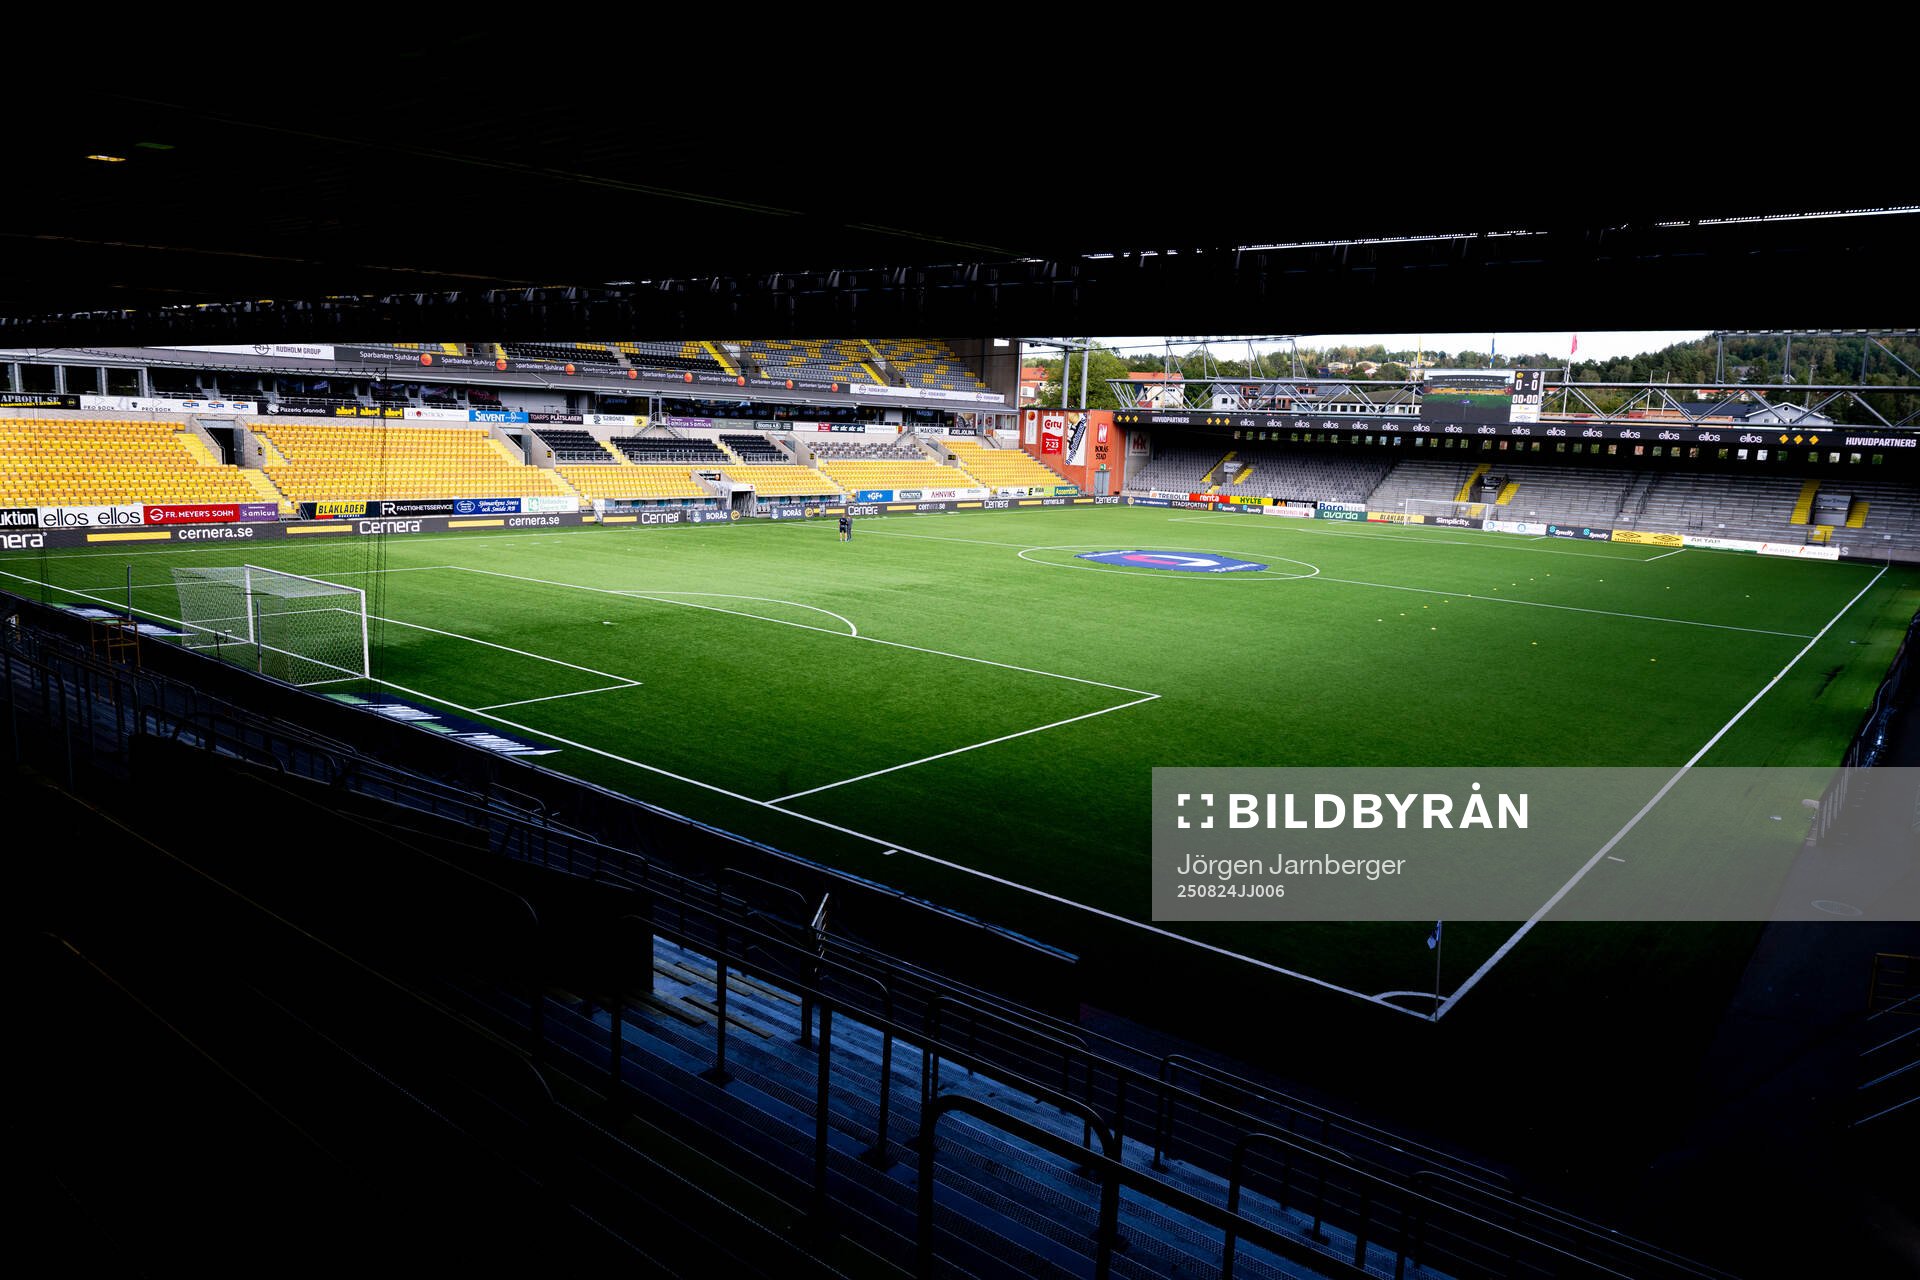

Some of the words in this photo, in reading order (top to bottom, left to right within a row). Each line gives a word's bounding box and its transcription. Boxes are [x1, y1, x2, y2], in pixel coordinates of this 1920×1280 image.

[303, 347, 321, 355] GROUP
[360, 351, 393, 360] Sparbanken
[441, 356, 472, 364] Sparbanken
[1516, 380, 1522, 390] 0
[1531, 380, 1538, 390] 0
[475, 411, 505, 422] SILVENT
[1267, 419, 1282, 427] ellos
[1294, 420, 1310, 428] ellos
[1322, 421, 1339, 429] ellos
[1352, 421, 1368, 430] ellos
[1382, 422, 1399, 431] ellos
[1413, 423, 1430, 432] ellos
[1445, 424, 1463, 433] ellos
[1478, 425, 1496, 434] ellos
[1511, 426, 1530, 435] ellos
[1546, 427, 1566, 436] ellos
[1582, 428, 1603, 437] ellos
[1620, 429, 1641, 439] ellos
[1658, 430, 1680, 440] ellos
[1699, 432, 1720, 442] ellos
[1739, 433, 1763, 443] ellos
[1845, 437, 1917, 448] HUVUDPARTNERS
[930, 490, 956, 498] AHNVIKS
[396, 503, 453, 512] FASTIGHETSSERVICE
[43, 508, 89, 526] ellos
[97, 507, 140, 525] ellos
[178, 510, 210, 518] MEYER'S
[706, 510, 728, 520] BORÅS
[783, 508, 801, 517] BORÅS
[1323, 511, 1358, 520] avarda
[508, 516, 560, 527] cernera.se
[359, 520, 420, 534] Cernera
[178, 527, 253, 540] cernera.se
